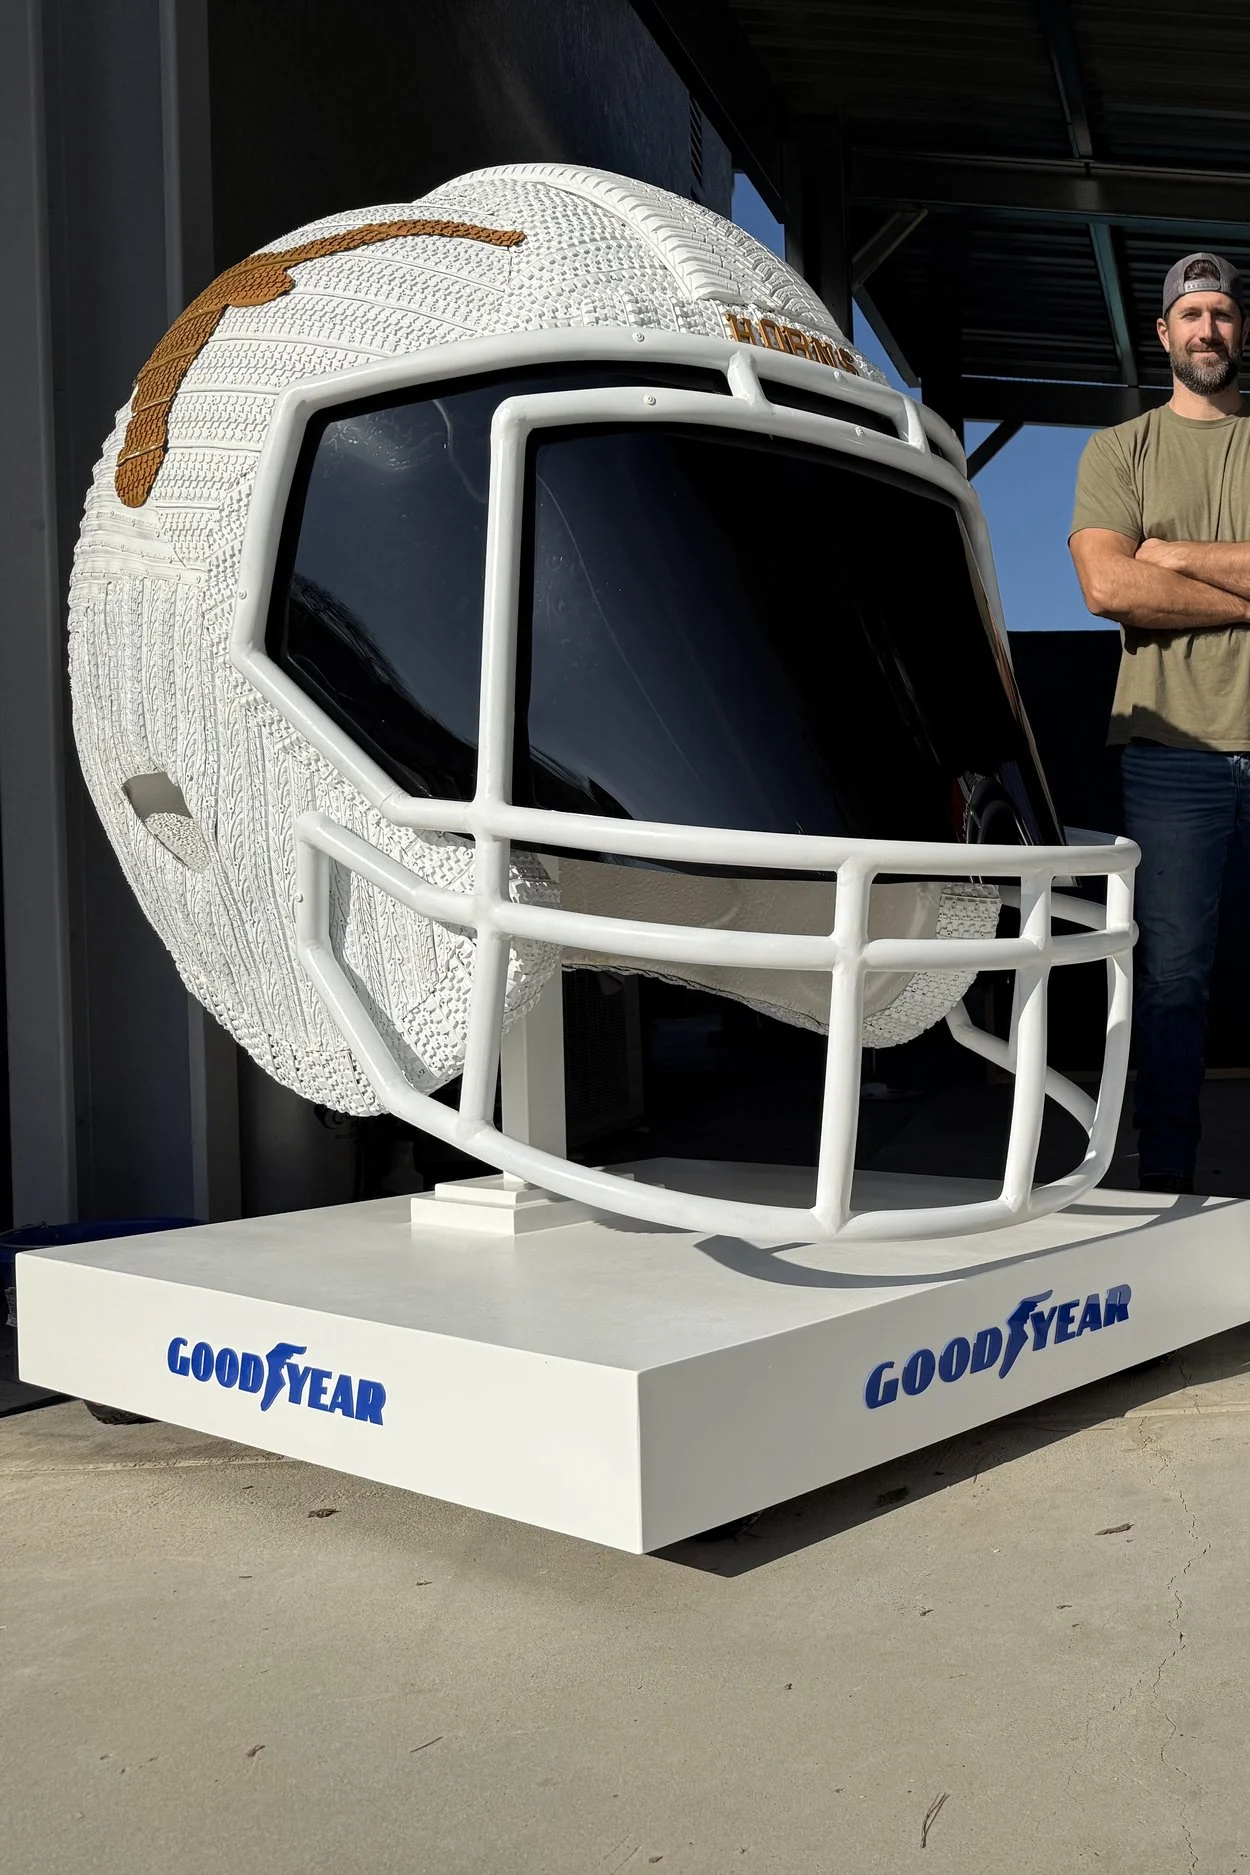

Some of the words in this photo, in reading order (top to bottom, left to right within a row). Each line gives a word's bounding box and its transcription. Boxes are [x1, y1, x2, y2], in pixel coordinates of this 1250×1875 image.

[725, 312, 860, 376] HORNS
[167, 1337, 386, 1425] GOODYEAR
[864, 1283, 1132, 1409] GOODYEAR
